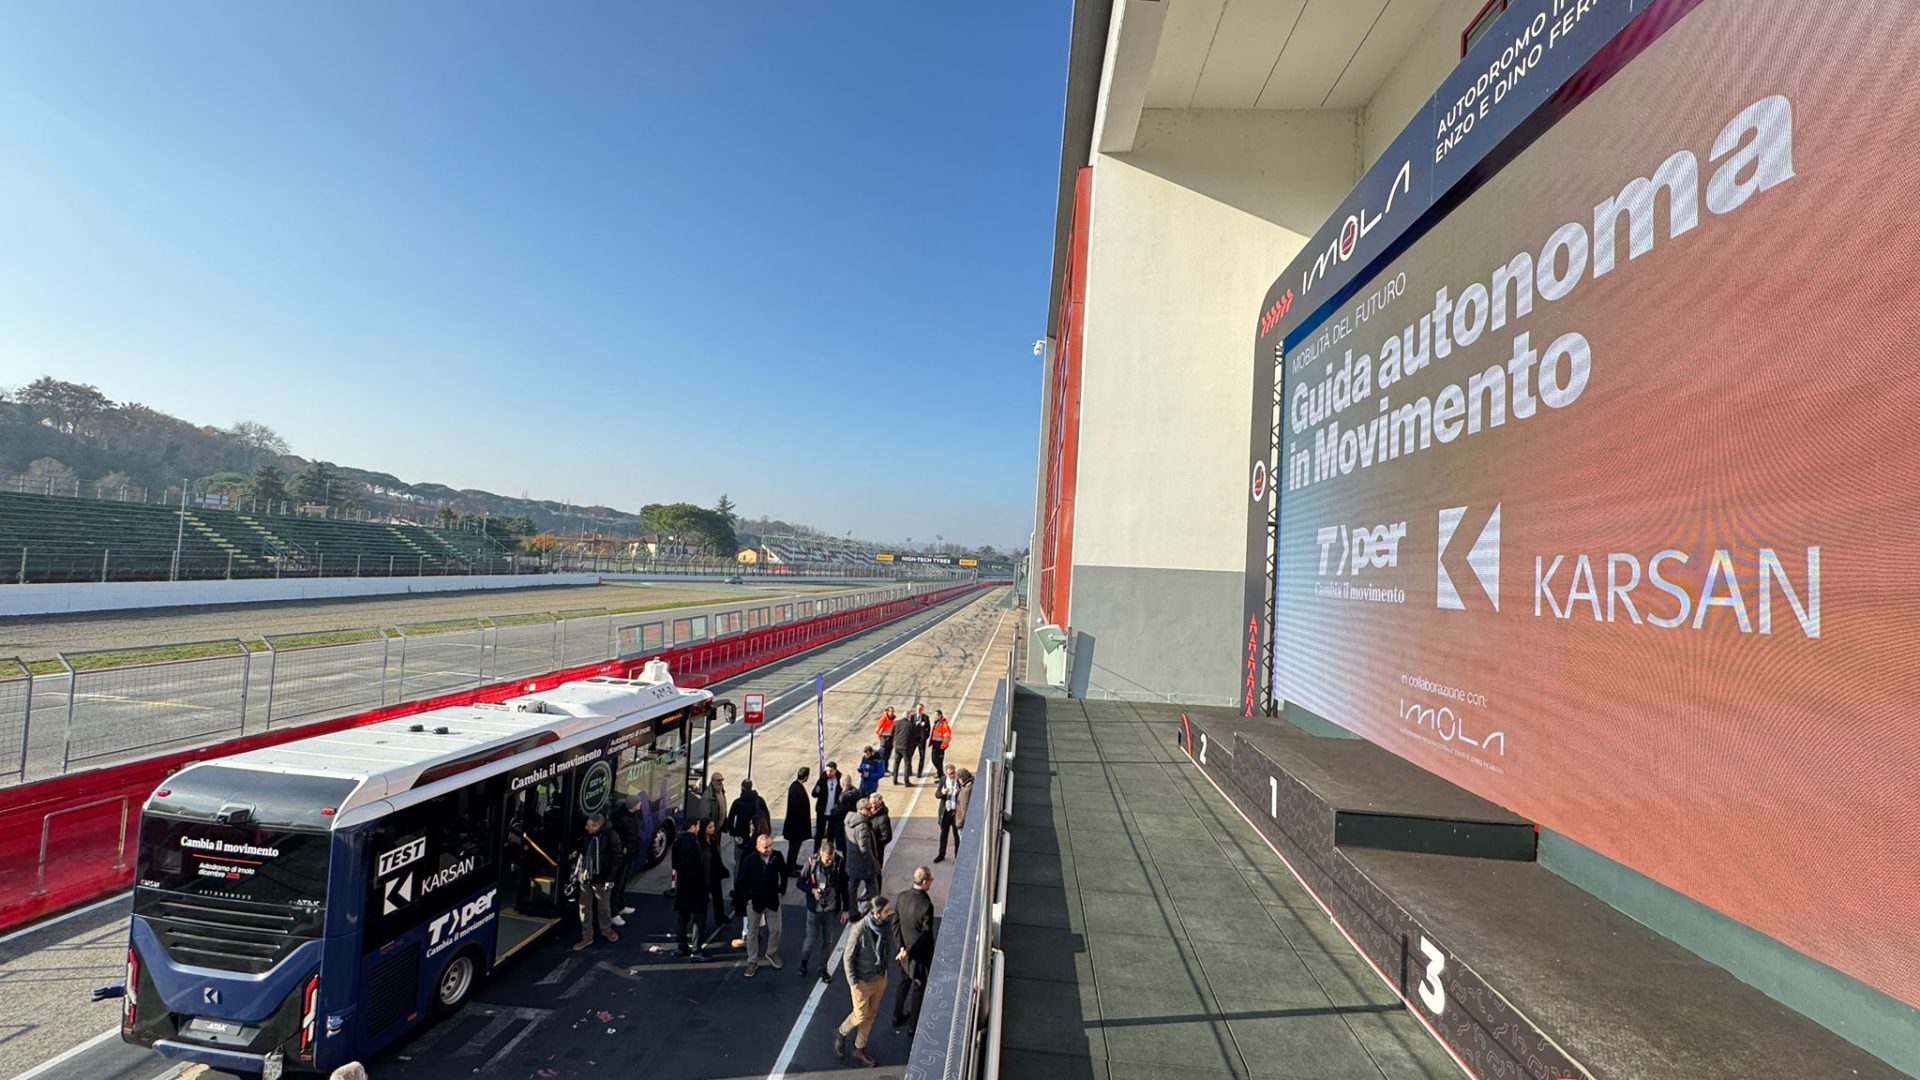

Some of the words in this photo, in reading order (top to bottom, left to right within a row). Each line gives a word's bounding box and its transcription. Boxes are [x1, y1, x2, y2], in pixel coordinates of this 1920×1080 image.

[1435, 113, 1475, 163] ENZO
[1479, 96, 1490, 120] E
[1495, 44, 1542, 104] DINO
[1549, 0, 1598, 49] FER
[1437, 12, 1546, 139] AUTODROMO
[1302, 160, 1410, 295] IMOLA
[1291, 348, 1372, 435] Guida
[1378, 94, 1796, 390] autonoma
[1292, 328, 1330, 375] MOBILITÀ
[1332, 316, 1352, 345] DEL
[1355, 272, 1406, 328] FUTURO
[1289, 442, 1311, 491] in
[1314, 331, 1592, 484] Movimento
[1343, 581, 1350, 599] il
[1350, 583, 1405, 604] movimento
[1534, 545, 1822, 640] KARSAN
[1408, 675, 1465, 702] collaborazione
[1466, 691, 1488, 708] con:
[1199, 733, 1207, 765] 2
[1400, 698, 1504, 756] IMOLA
[511, 768, 548, 791] Cambia
[549, 762, 556, 776] il
[557, 748, 602, 773] movimento
[1269, 776, 1277, 819] 1
[181, 835, 215, 850] Cambia
[216, 840, 223, 851] il
[224, 843, 279, 858] movimento
[381, 841, 424, 873] TEST
[421, 856, 475, 896] KARSAN
[426, 937, 453, 958] Cambia
[459, 912, 495, 938] movimento
[1418, 936, 1445, 1015] 3
